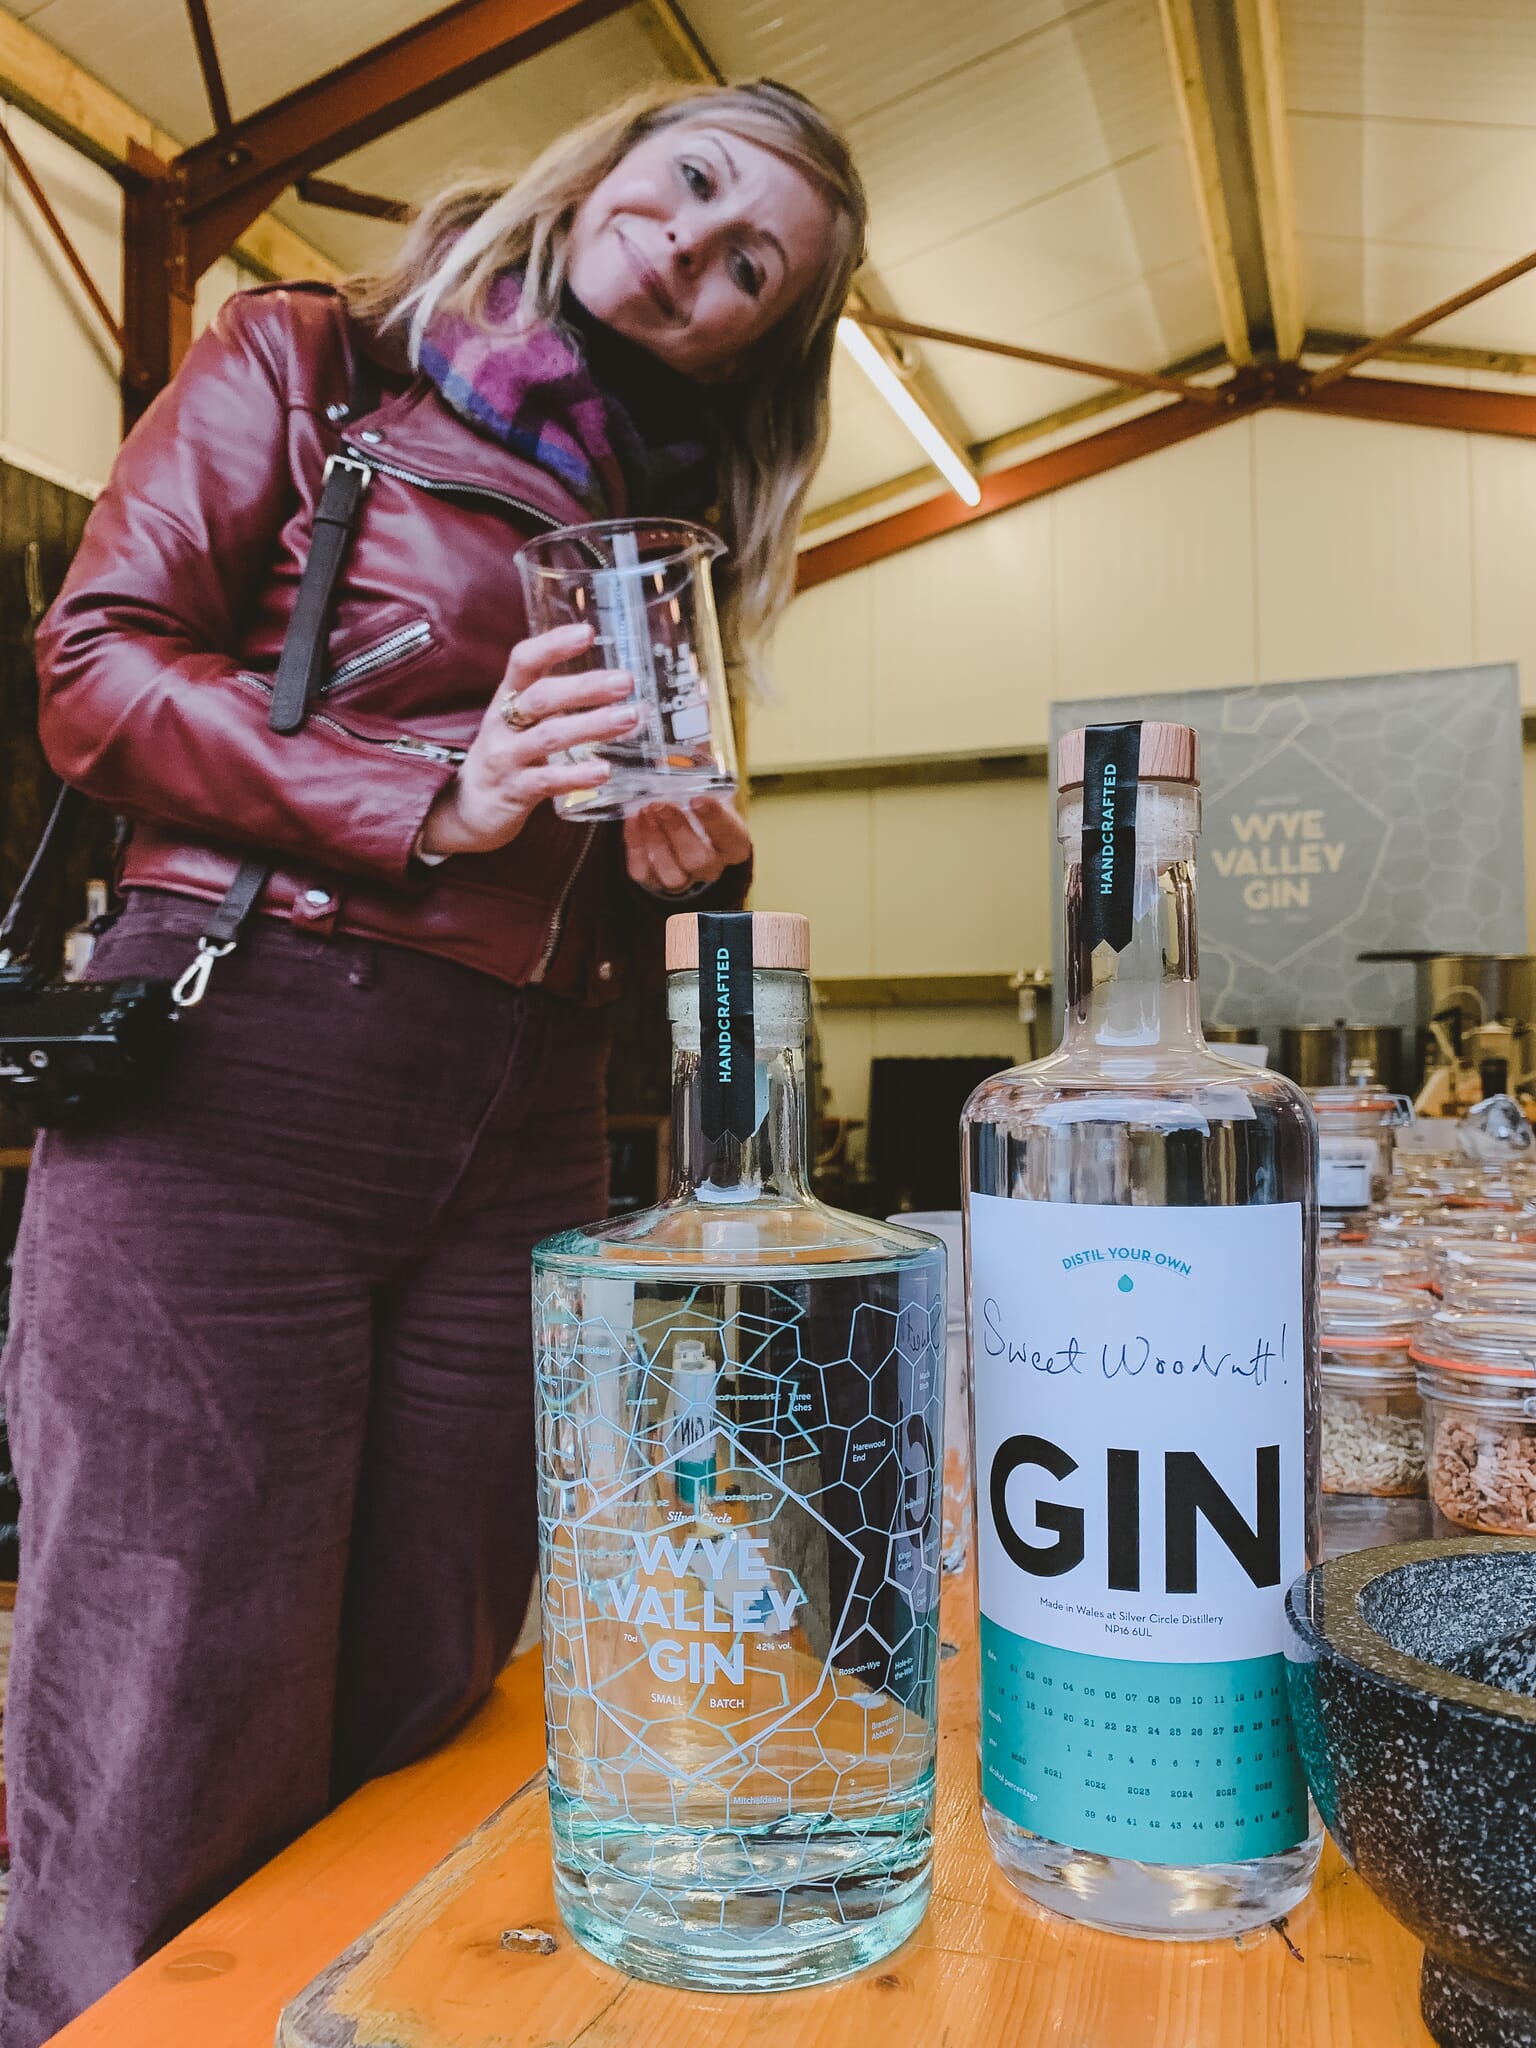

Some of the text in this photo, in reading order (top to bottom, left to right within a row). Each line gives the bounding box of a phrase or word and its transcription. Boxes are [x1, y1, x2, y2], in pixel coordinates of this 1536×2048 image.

[1100, 763, 1117, 895] HANDCRAFTED
[1231, 809, 1326, 843] WYE
[1212, 841, 1345, 878] VALLEY
[1243, 878, 1310, 910] GIN
[716, 947, 732, 1083] HANDCRAFTED
[1062, 1247, 1192, 1275] DISTIL YOUR OWN
[984, 1298, 1086, 1374] Sweet
[788, 1392, 811, 1401] Three
[852, 1439, 886, 1452] Harewood
[852, 1453, 866, 1462] End
[667, 1511, 733, 1523] Silver Circle
[990, 1434, 1281, 1593] GIN
[632, 1533, 769, 1580] WYE
[607, 1578, 801, 1632] VALLEY
[1040, 1597, 1224, 1625] Made in Wales at Silver Circle Distillery
[624, 1633, 638, 1643] 70cl
[1104, 1624, 1153, 1637] NP16 6UL
[756, 1641, 792, 1651] 42% vol.
[649, 1639, 745, 1685] GIN
[839, 1661, 880, 1676] Ross-on-Wye
[651, 1693, 745, 1709] SMALL BATCH
[1025, 1670, 1035, 1680] 02
[1042, 1676, 1053, 1686] 03
[1063, 1682, 1074, 1692] 04
[1084, 1687, 1096, 1697] 05
[1104, 1690, 1117, 1700] 06
[1125, 1693, 1137, 1702] 07
[1147, 1695, 1160, 1704] 08
[1169, 1696, 1182, 1705] 09
[1191, 1696, 1203, 1705] 10
[1214, 1695, 1225, 1704] 11
[1235, 1693, 1245, 1702] 12
[1026, 1700, 1036, 1711] 18
[1044, 1707, 1053, 1717] 19
[1063, 1713, 1074, 1723] 20
[1083, 1718, 1095, 1728] 21
[1104, 1722, 1117, 1731] 22
[1125, 1724, 1137, 1734] 23
[1148, 1726, 1160, 1736] 24
[1169, 1728, 1182, 1736] 25
[1191, 1728, 1203, 1736] 26
[1213, 1727, 1224, 1736] 27
[1087, 1749, 1093, 1758] 2
[1108, 1753, 1114, 1761] 3
[1129, 1756, 1134, 1764] 4
[1151, 1758, 1157, 1767] 5
[1172, 1759, 1178, 1768] 6
[1194, 1759, 1200, 1768] 7
[1044, 1766, 1063, 1779] 2021
[1084, 1779, 1107, 1791] 2022
[1127, 1786, 1151, 1796] 2023
[1170, 1790, 1193, 1798] 2024
[1216, 1788, 1237, 1797] 2025
[1085, 1810, 1096, 1819] 39
[1106, 1814, 1117, 1823] 40
[1126, 1818, 1137, 1826] 41
[1149, 1820, 1160, 1829] 42
[1170, 1821, 1182, 1830] 43
[1192, 1822, 1203, 1830] 44
[1214, 1821, 1225, 1829] 45
